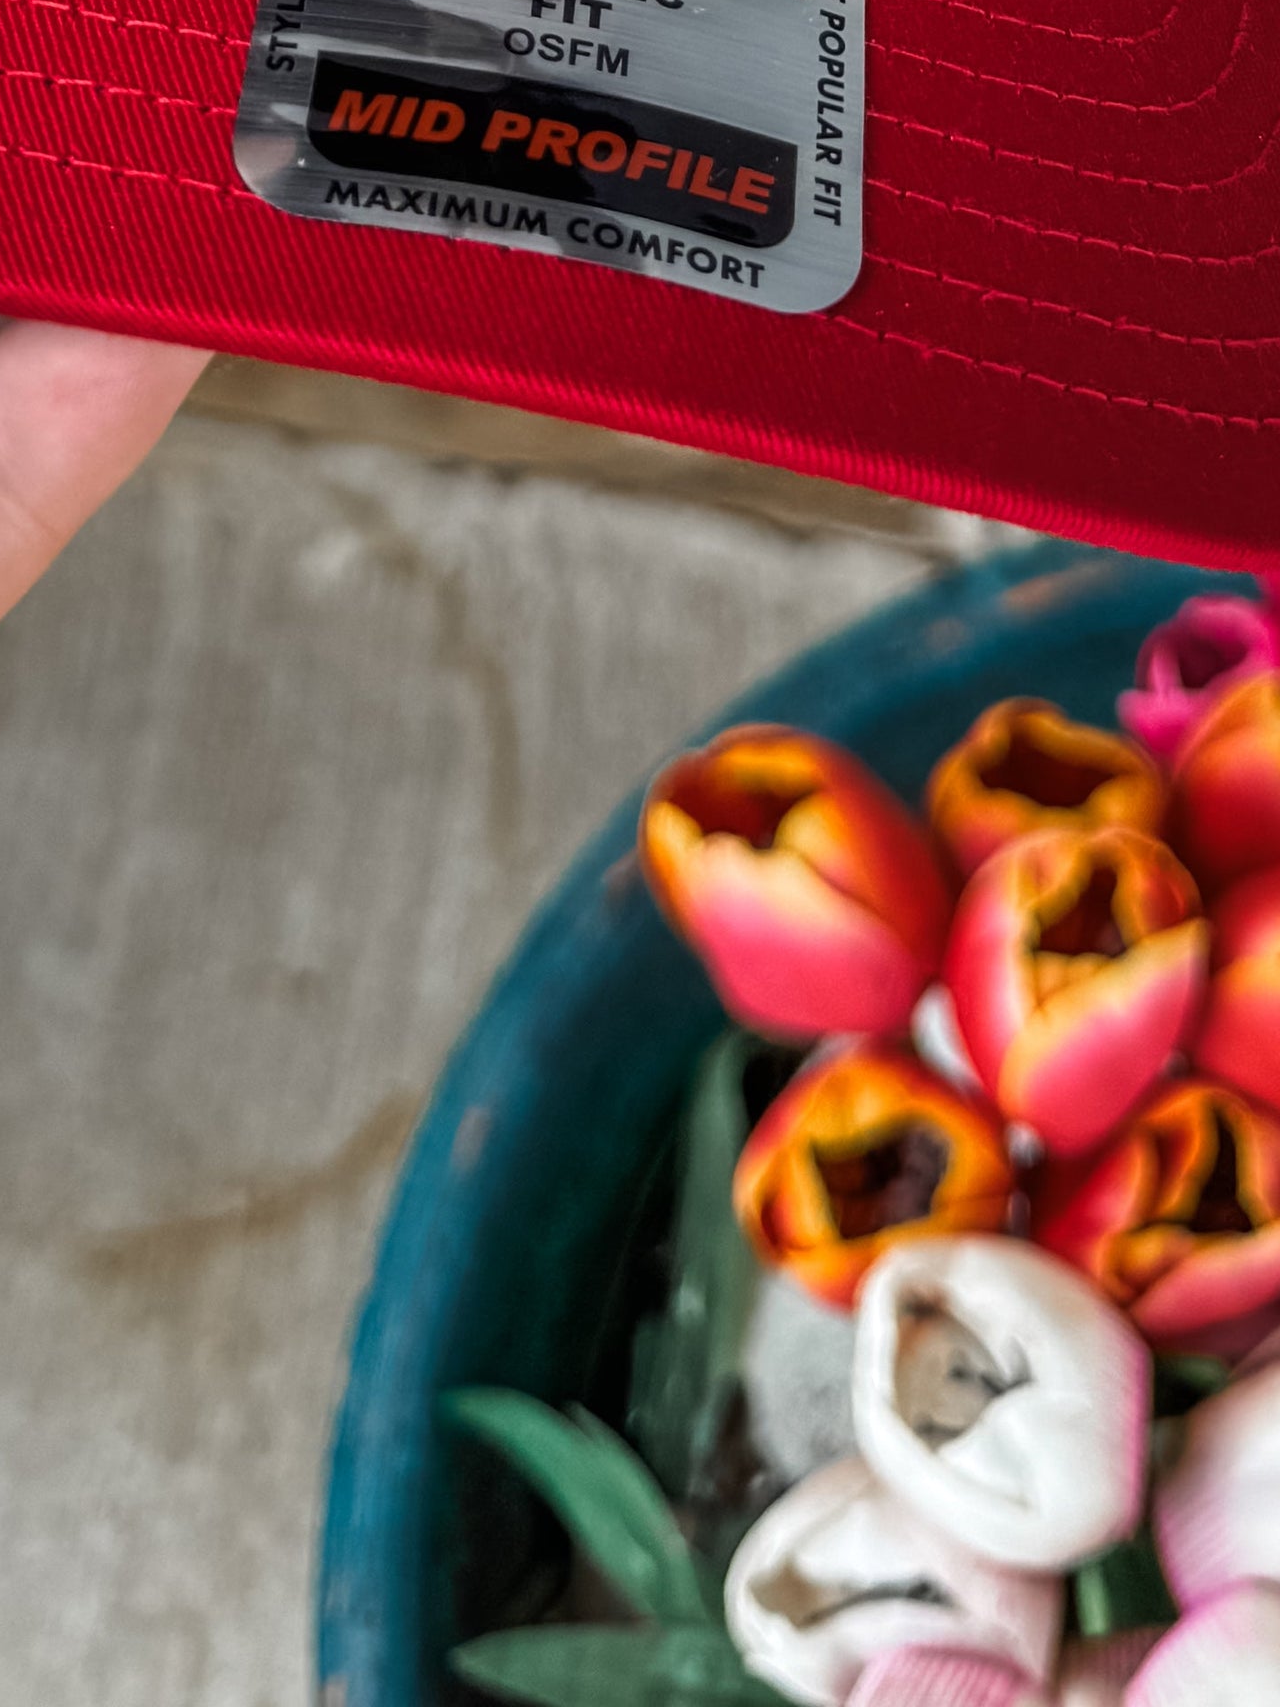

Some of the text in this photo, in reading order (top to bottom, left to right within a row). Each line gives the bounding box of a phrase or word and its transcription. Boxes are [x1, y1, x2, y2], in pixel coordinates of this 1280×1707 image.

[502, 27, 631, 77] OSFM
[814, 8, 846, 164] POPULAR
[327, 89, 776, 215] MID PROFILE
[812, 175, 842, 227] FIT
[324, 179, 765, 289] MAXIMUM COMFORT
